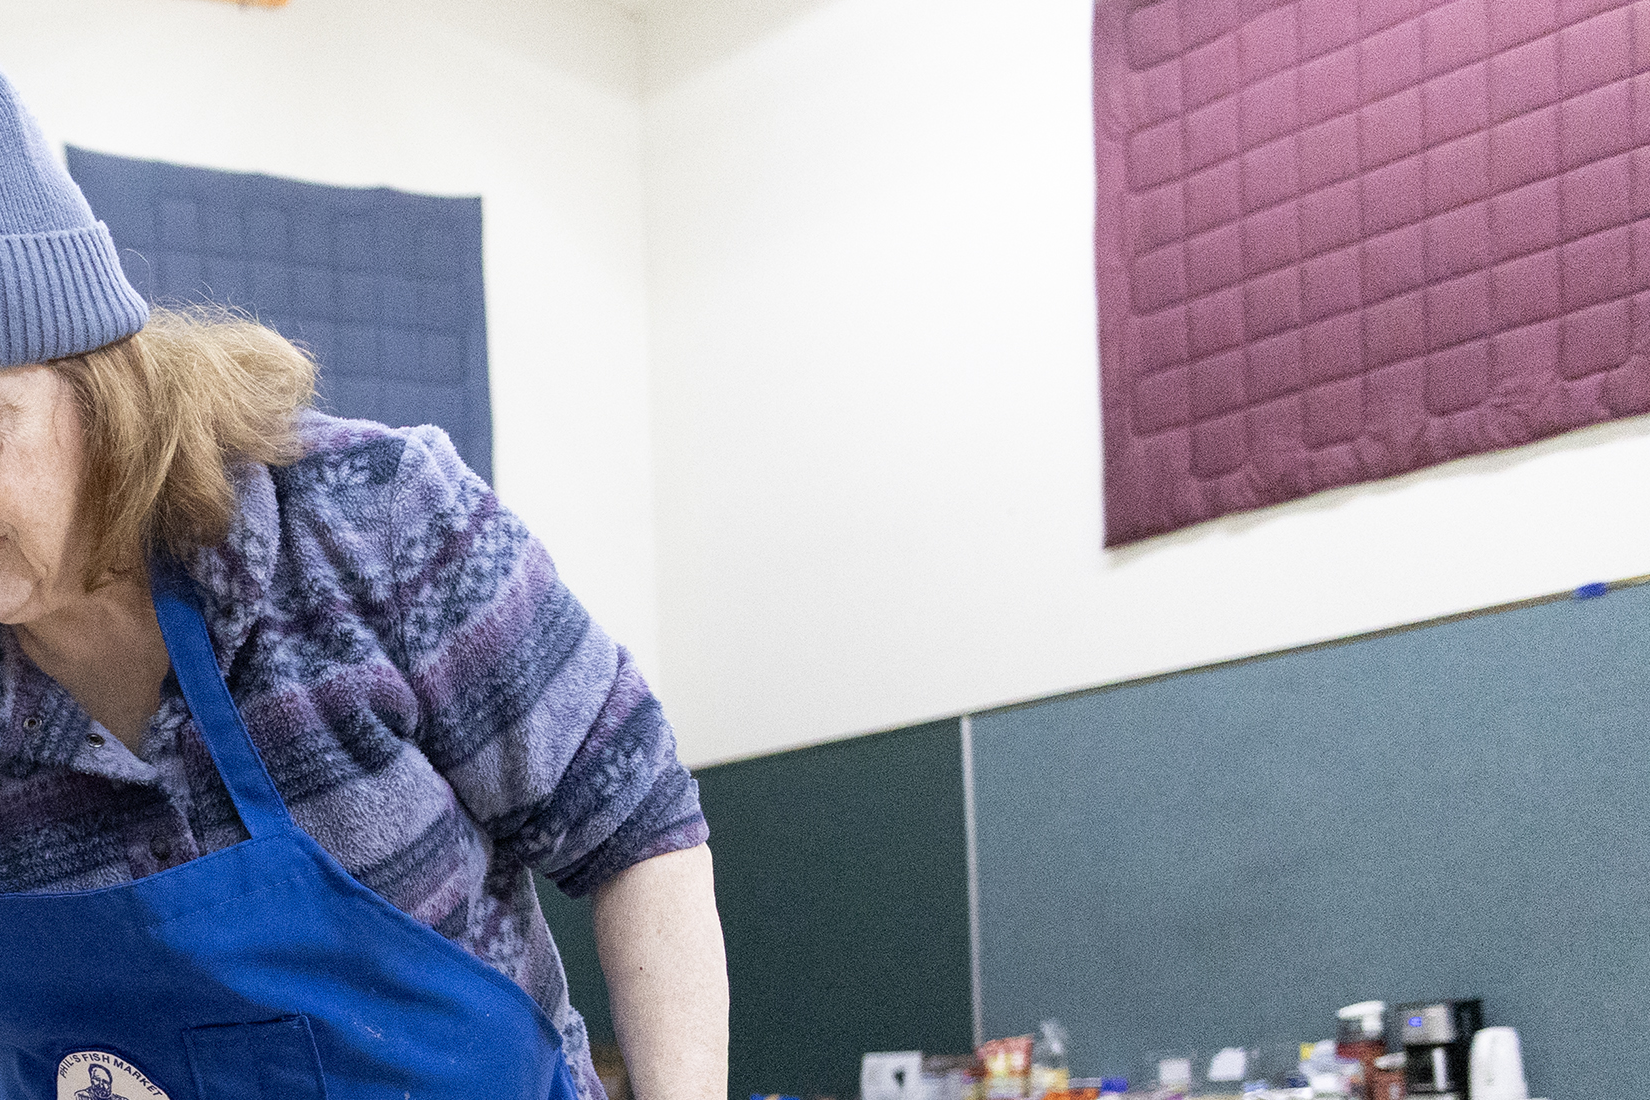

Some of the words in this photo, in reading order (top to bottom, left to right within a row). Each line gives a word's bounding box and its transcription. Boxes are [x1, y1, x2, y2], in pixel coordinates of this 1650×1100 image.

[59, 1054, 81, 1078] PHIL'S
[82, 1053, 110, 1064] FISH
[113, 1059, 163, 1097] MARKET
